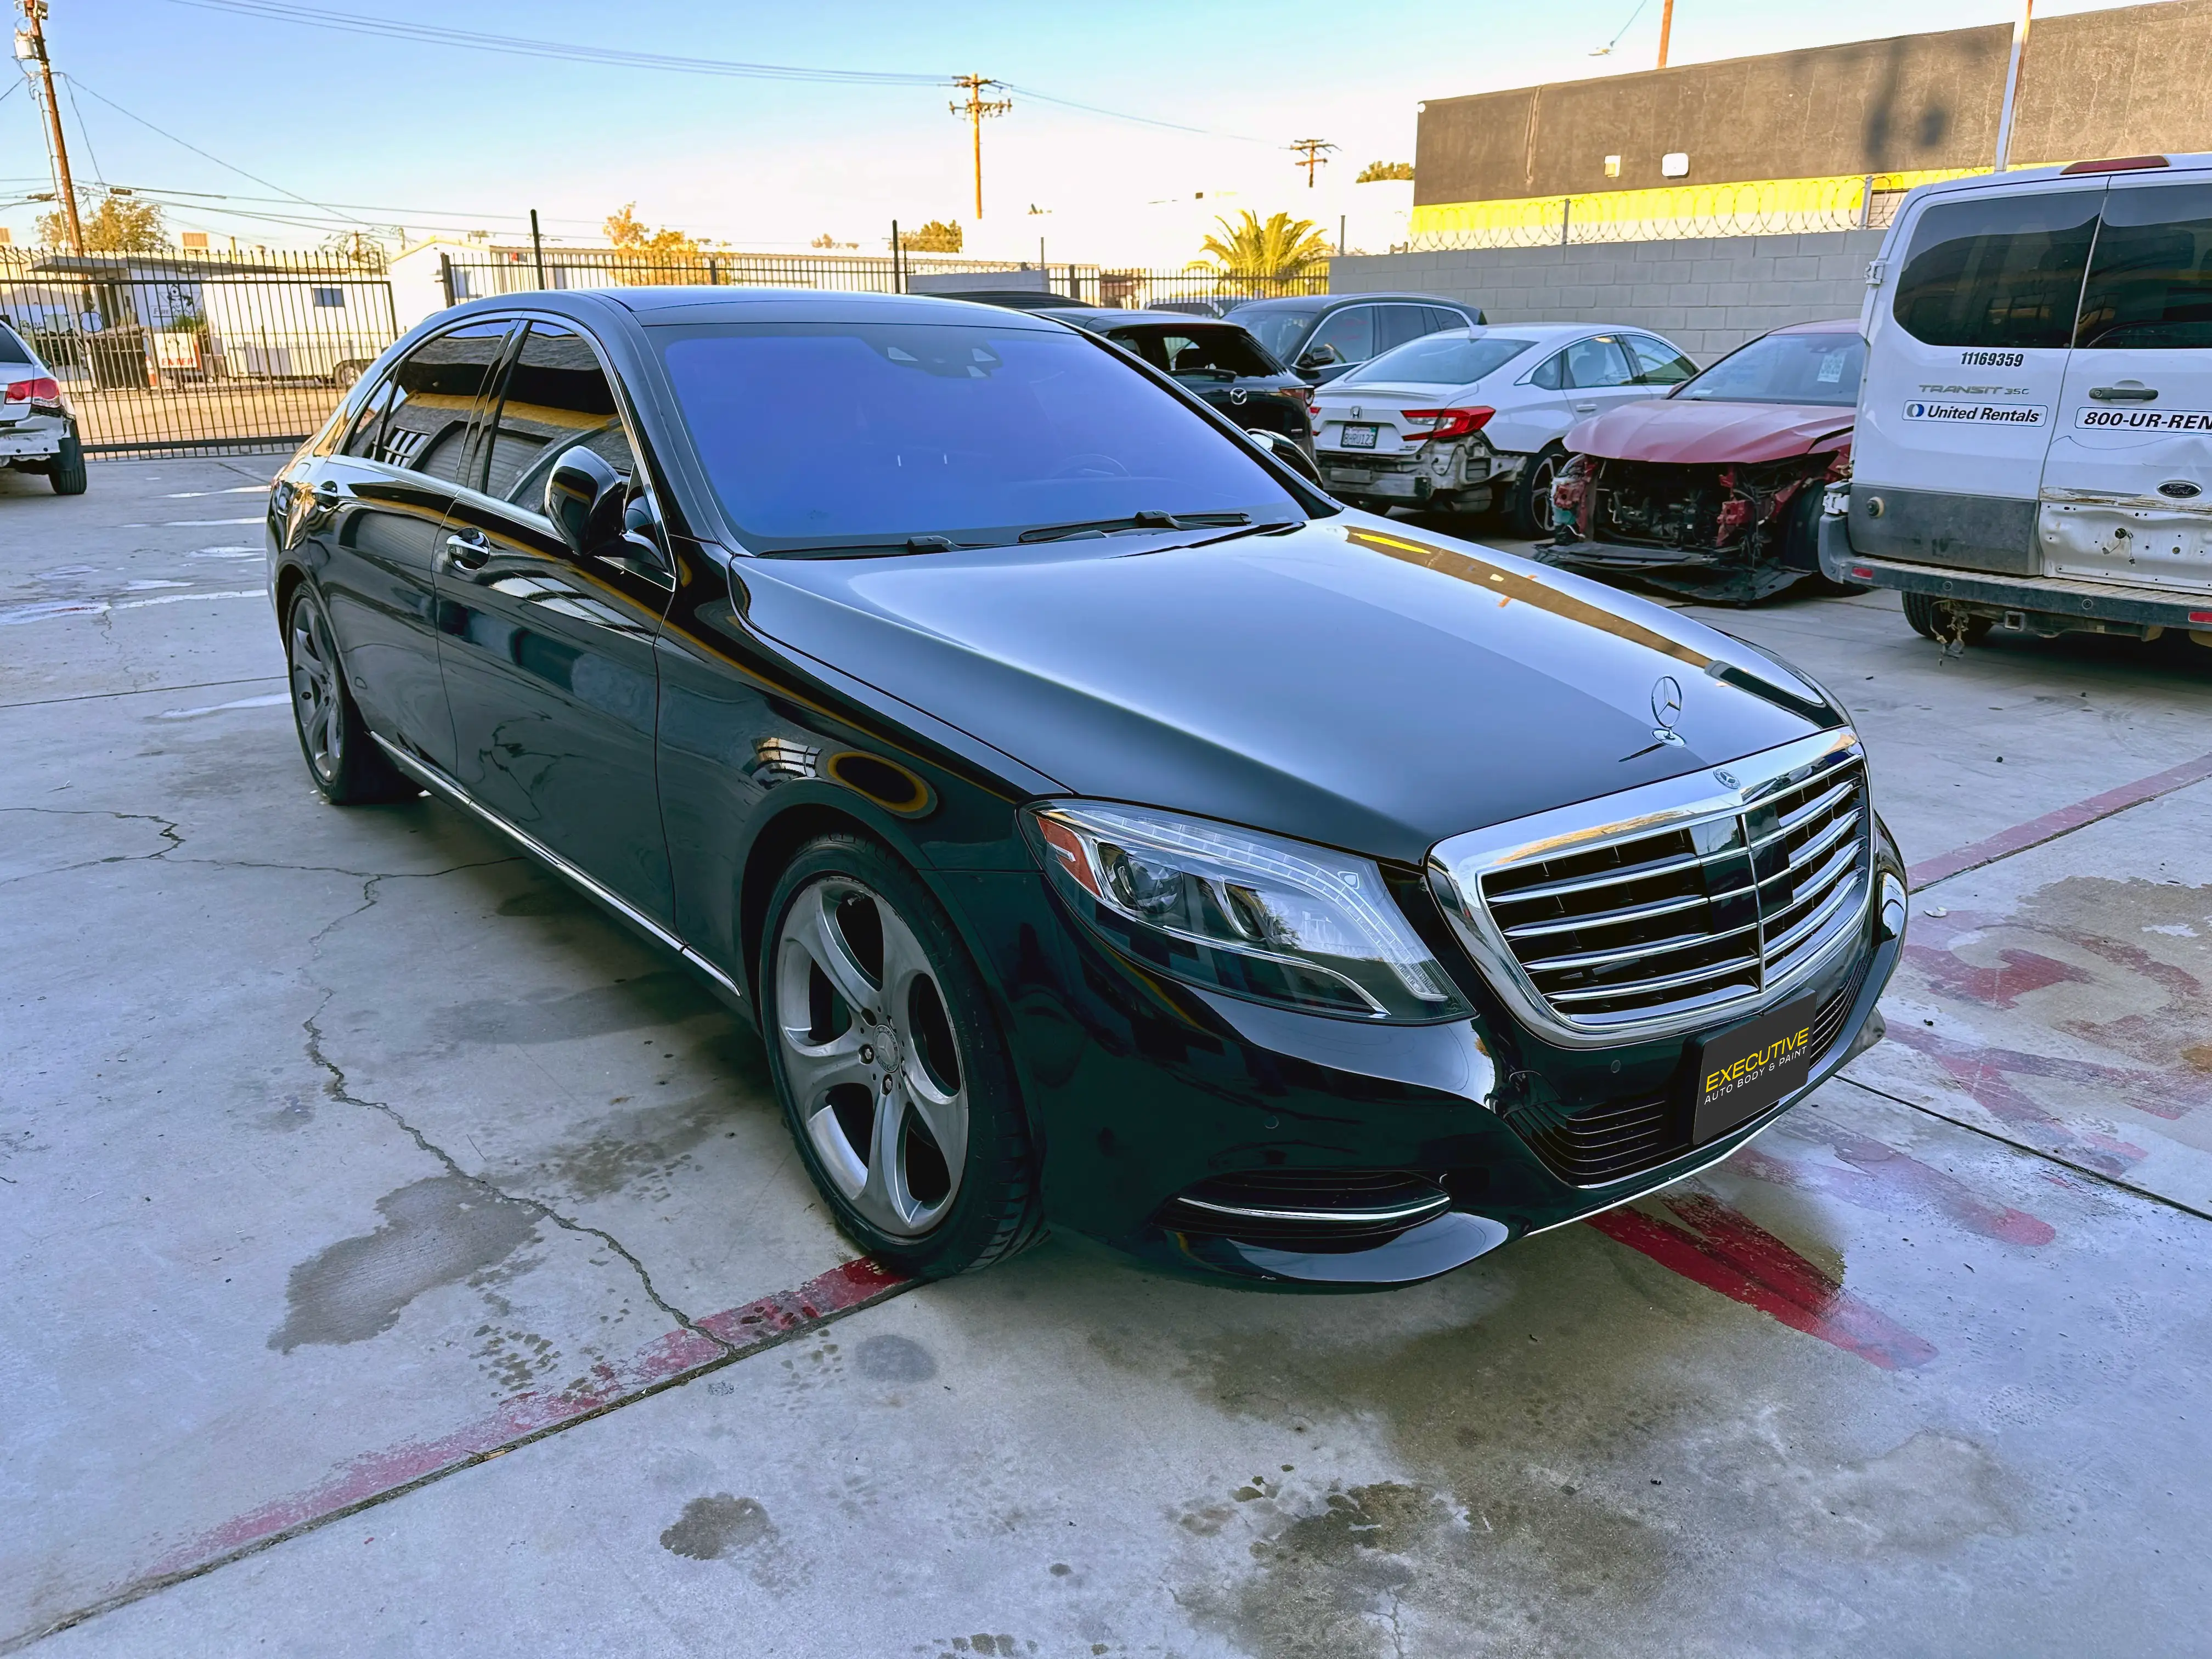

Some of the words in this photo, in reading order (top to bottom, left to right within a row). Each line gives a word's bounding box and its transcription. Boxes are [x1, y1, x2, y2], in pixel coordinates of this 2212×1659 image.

[162, 358, 194, 366] ENTER
[1960, 352, 2024, 367] 11169359
[1919, 385, 2004, 394] TRANSIT
[1927, 405, 1979, 420] United
[1980, 407, 2040, 422] Rentals
[2084, 411, 2212, 430] 800-UR-REN
[1705, 1026, 1809, 1093] EXECUTIVE
[1704, 1084, 1734, 1105] AUTO
[1737, 1069, 1764, 1088] BODY
[1768, 1063, 1775, 1071] &
[1779, 1046, 1807, 1067] PAINT
